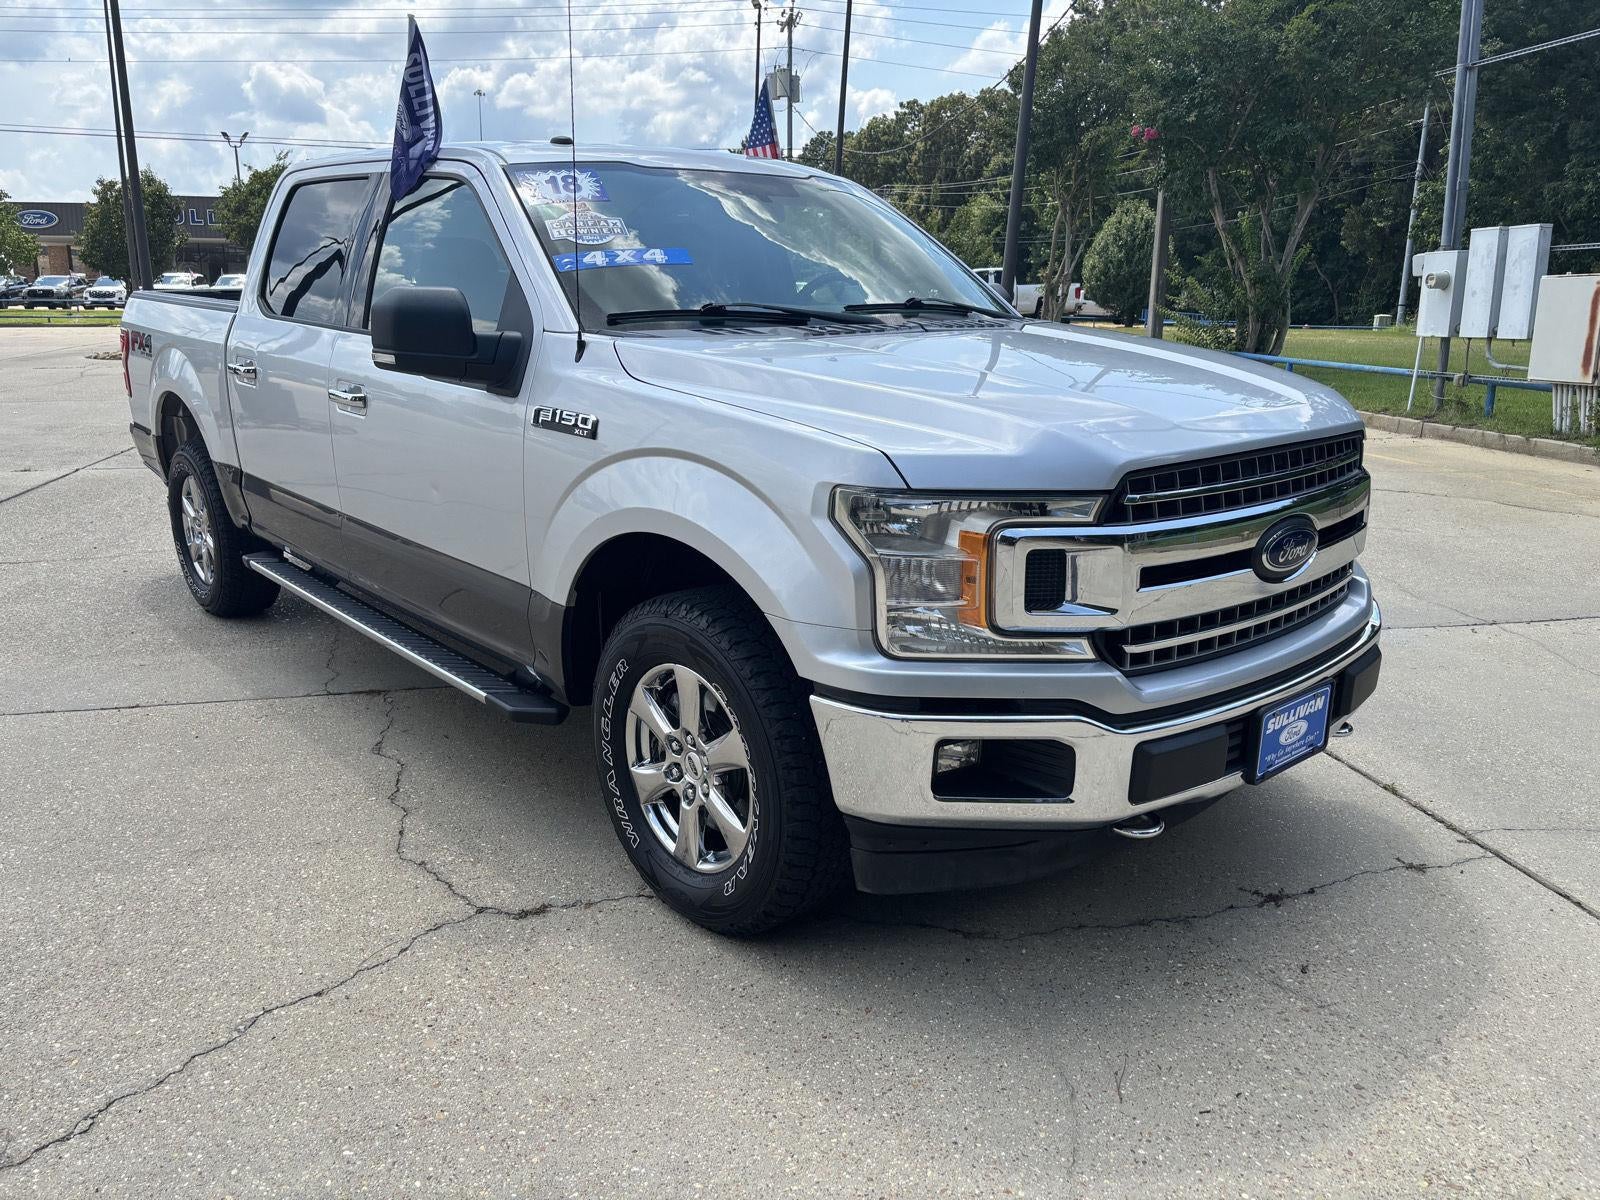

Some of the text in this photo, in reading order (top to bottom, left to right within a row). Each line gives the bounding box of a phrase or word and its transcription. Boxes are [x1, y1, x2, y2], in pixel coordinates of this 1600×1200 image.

[544, 175, 583, 194] 18
[552, 220, 620, 229] CARFAX
[574, 428, 589, 436] XLT
[1278, 534, 1310, 563] Ford
[1266, 695, 1326, 735] SULLIVAN
[600, 658, 640, 849] WRANGLER
